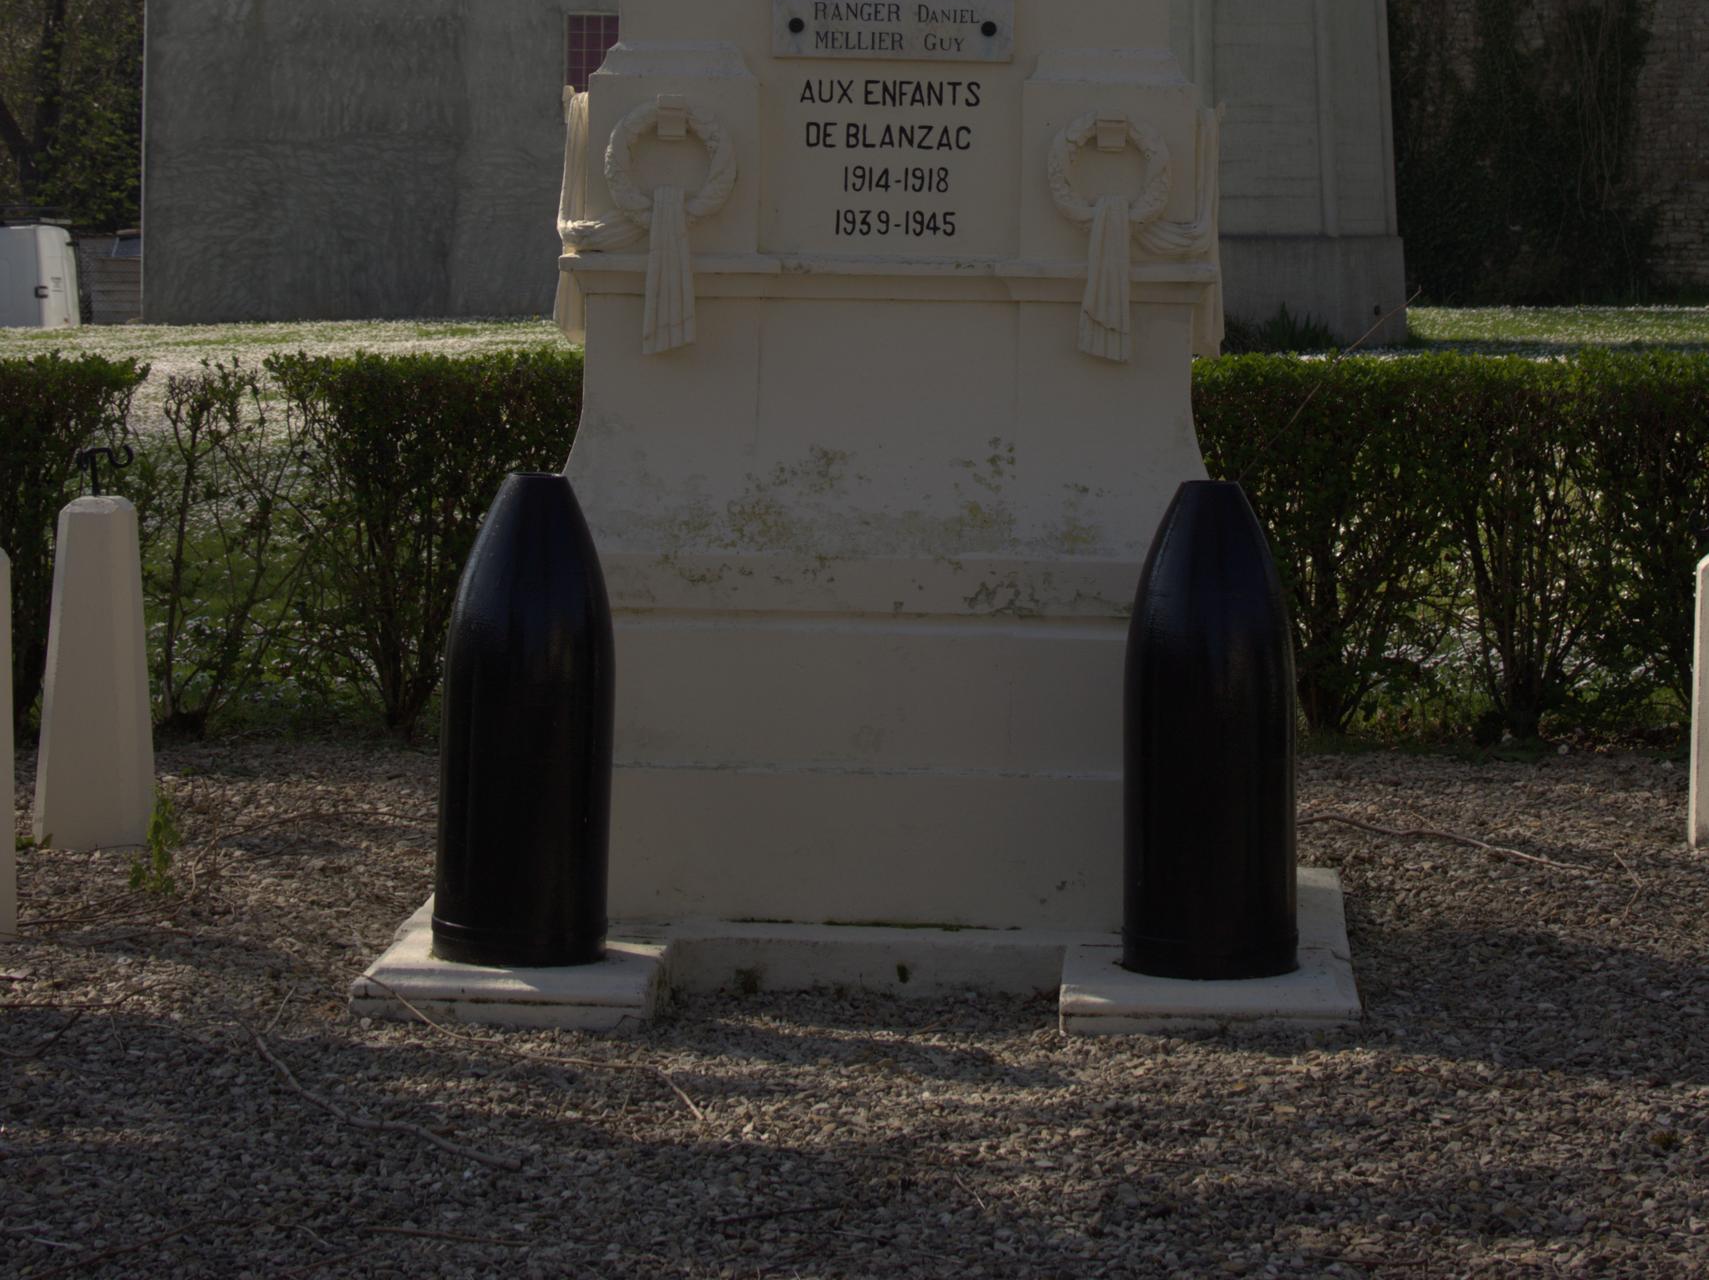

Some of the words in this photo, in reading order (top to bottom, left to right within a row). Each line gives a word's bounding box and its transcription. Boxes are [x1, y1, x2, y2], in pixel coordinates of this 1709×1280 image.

[814, 2, 900, 22] RANGER
[918, 3, 980, 24] DANIEL
[815, 31, 904, 51] MELLIER
[924, 33, 966, 52] GUY
[800, 79, 854, 104] AUX
[864, 80, 981, 107] ENFANTS
[806, 122, 838, 148] DE
[846, 123, 972, 150] BLANZAC
[844, 166, 950, 193] 1914-1918
[835, 209, 956, 237] 1939-1945
